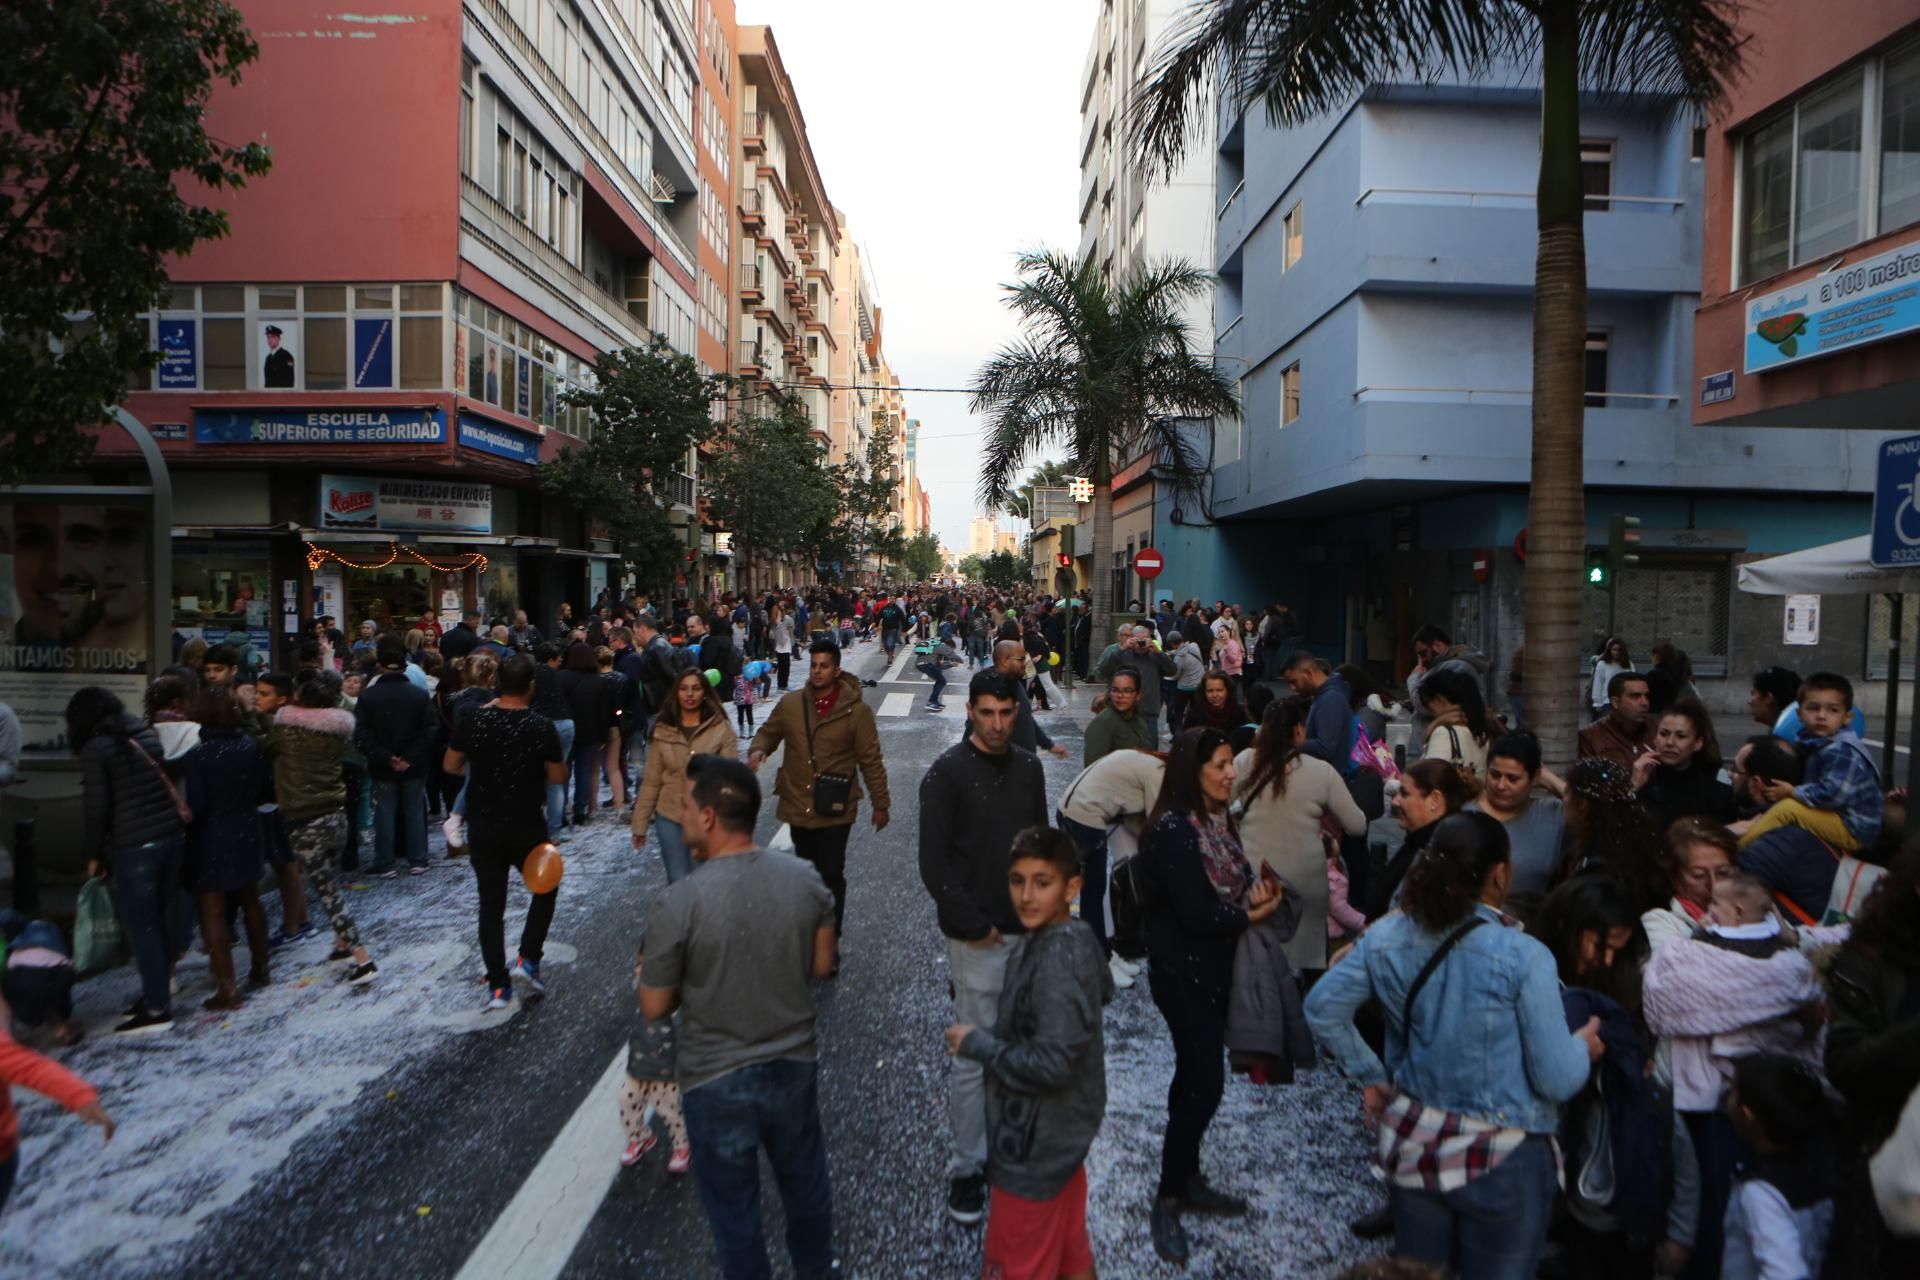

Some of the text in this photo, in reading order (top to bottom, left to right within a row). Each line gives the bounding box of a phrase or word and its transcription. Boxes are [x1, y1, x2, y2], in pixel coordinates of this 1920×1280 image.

[1820, 284, 1833, 303] a
[1835, 267, 1867, 298] 100
[258, 421, 441, 440] SUPERIOR DE SEGURIDAD
[307, 413, 390, 426] ESCUELA
[329, 488, 374, 513] Kalise
[379, 481, 491, 501] MINIMERCADO ENRIQUE
[0, 645, 138, 670] NTAMOS TODOS
